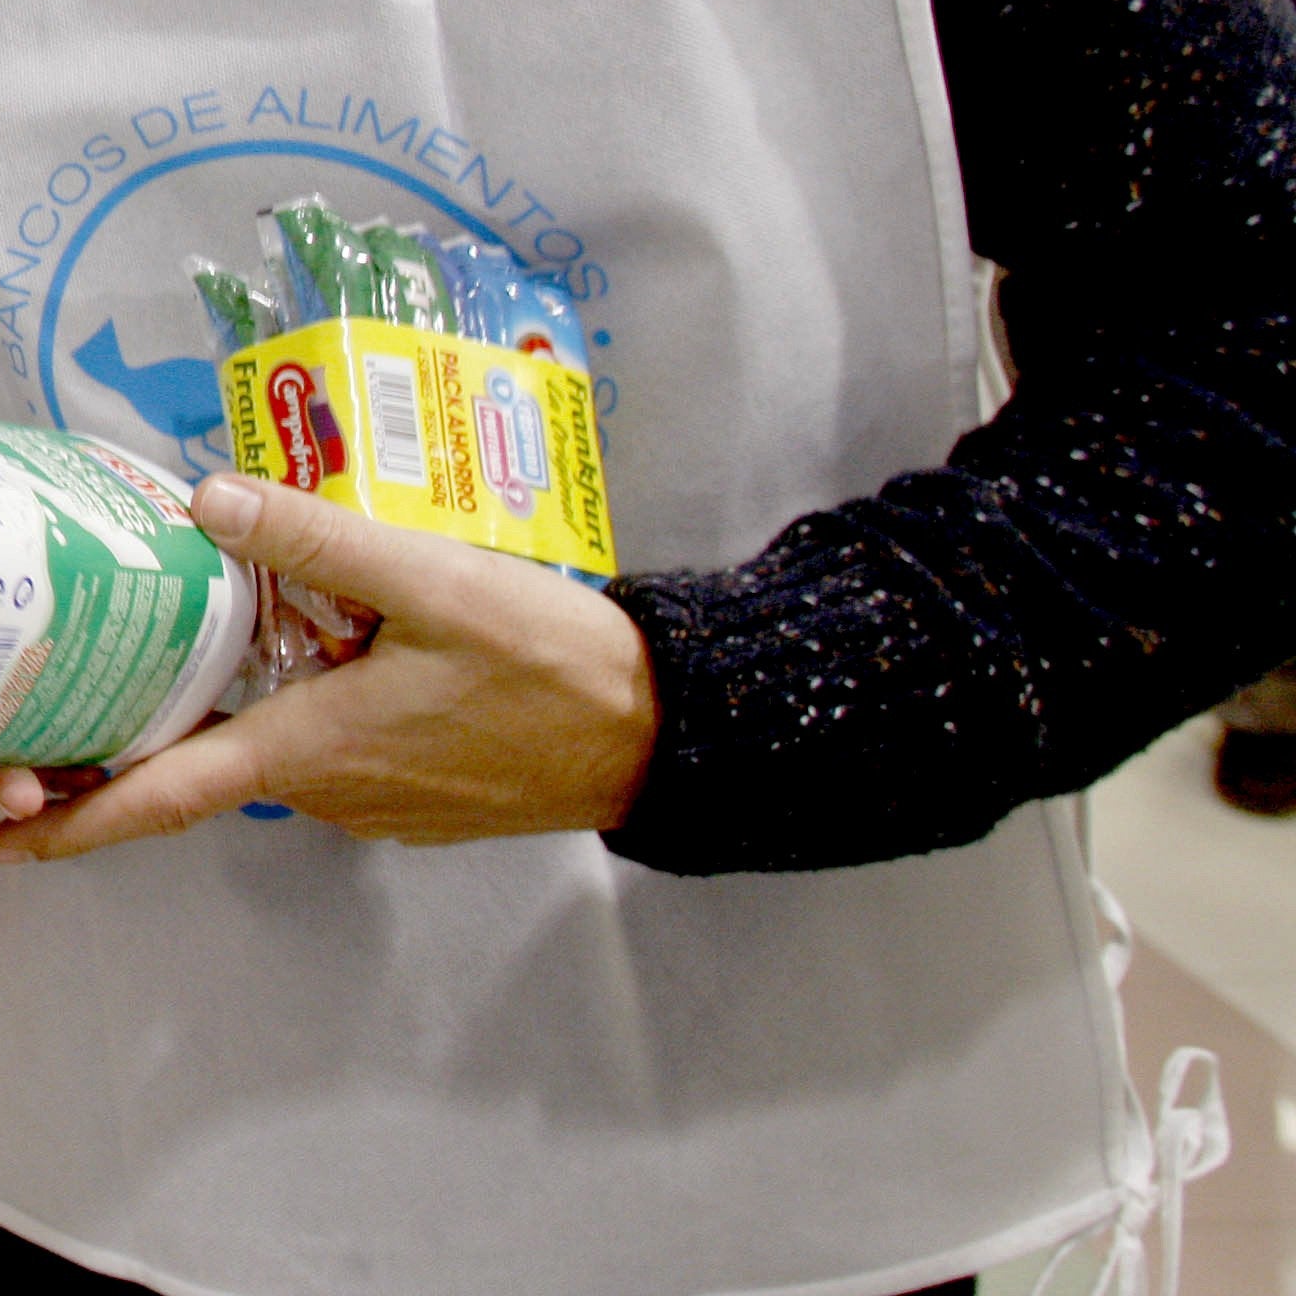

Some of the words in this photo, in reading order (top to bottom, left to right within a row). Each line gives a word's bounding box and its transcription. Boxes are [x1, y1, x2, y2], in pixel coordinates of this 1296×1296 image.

[130, 91, 225, 150] DE
[246, 85, 610, 304] ALIMENTOS
[440, 352, 464, 411] PACK
[448, 414, 477, 513] AHORRO
[567, 375, 606, 556] Frankfurt
